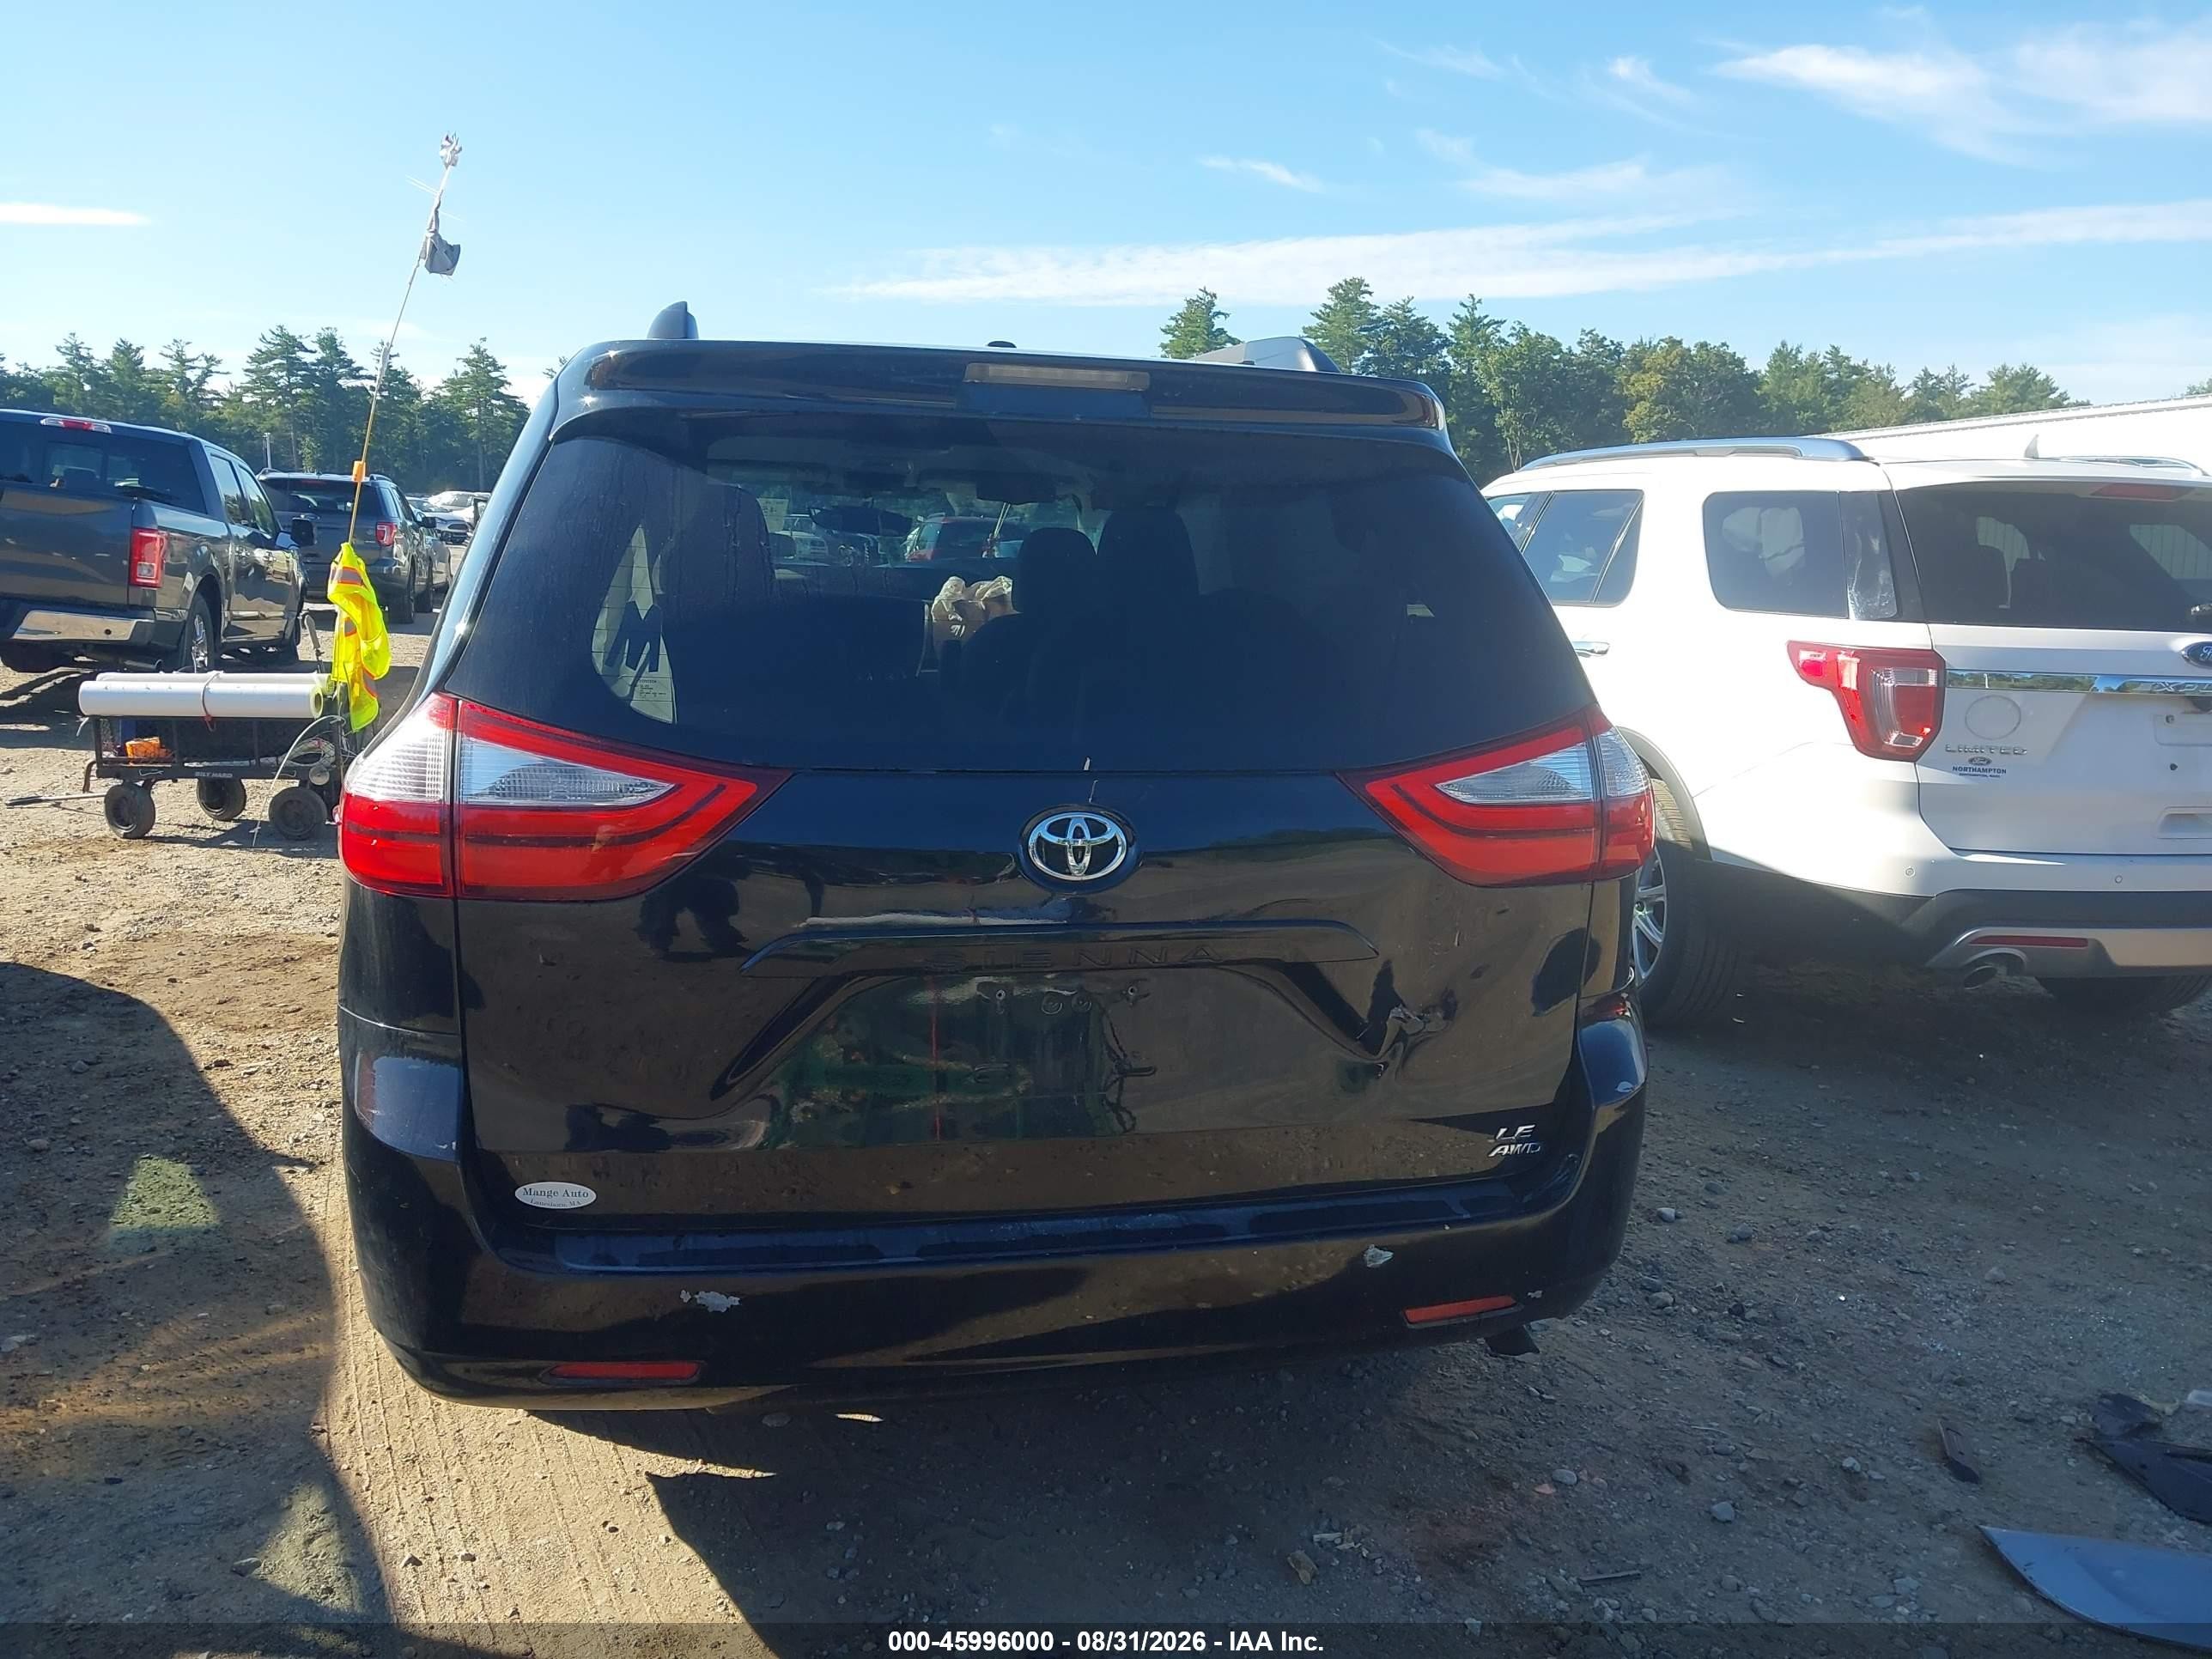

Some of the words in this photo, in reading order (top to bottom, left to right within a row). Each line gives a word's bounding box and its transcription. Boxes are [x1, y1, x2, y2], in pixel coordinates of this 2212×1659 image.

[1945, 744, 2027, 756] LIMITED
[1952, 766, 2007, 775] NORTHAMPTON
[925, 945, 1224, 972] SIENNA
[1496, 1124, 1535, 1139] LE
[1488, 1143, 1541, 1157] AWD
[522, 1188, 559, 1199] Mange
[562, 1189, 589, 1198] Auto
